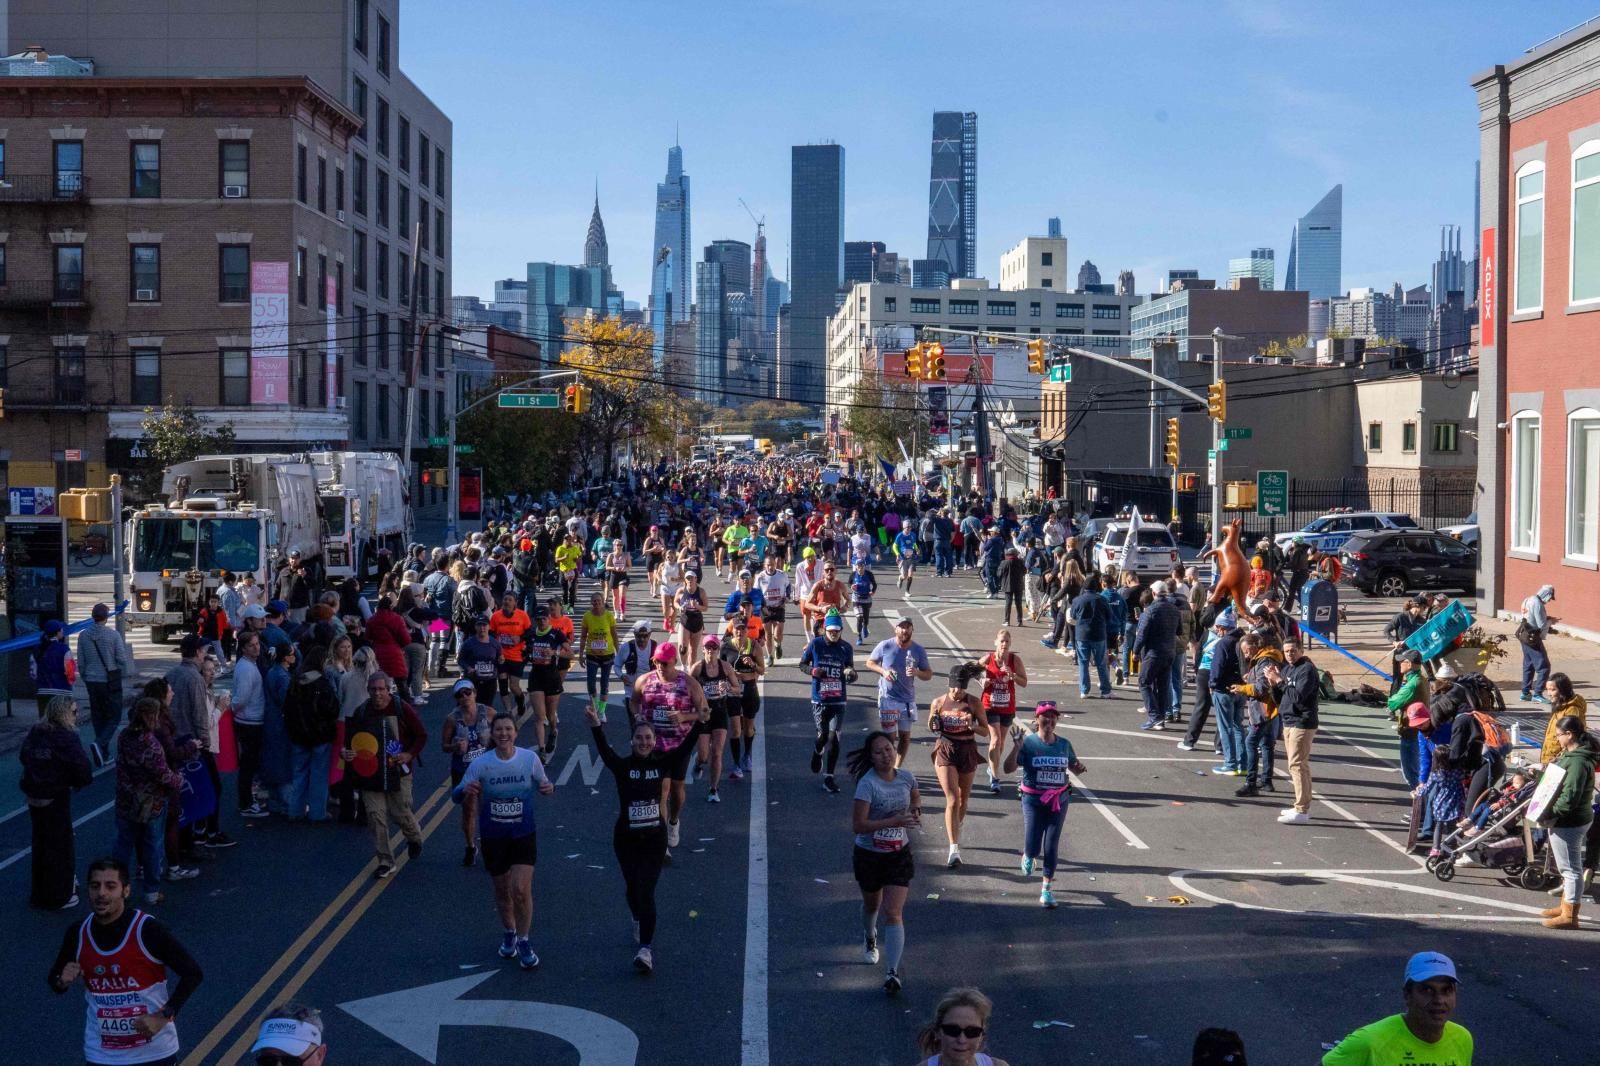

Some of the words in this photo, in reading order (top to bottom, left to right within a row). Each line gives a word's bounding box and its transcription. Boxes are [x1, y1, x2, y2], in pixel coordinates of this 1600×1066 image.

[253, 296, 286, 317] 551
[518, 396, 524, 405] 11
[529, 396, 540, 405] St
[1230, 429, 1237, 438] 11
[130, 449, 148, 458] BAR
[629, 769, 640, 779] GO
[488, 775, 526, 785] CAMILA
[492, 803, 521, 813] 43008
[631, 806, 658, 817] 28108
[877, 828, 903, 838] 42275
[89, 976, 140, 990] ITALIA
[95, 993, 141, 1006] GIUSEPPE
[268, 1023, 297, 1031] RUNNING
